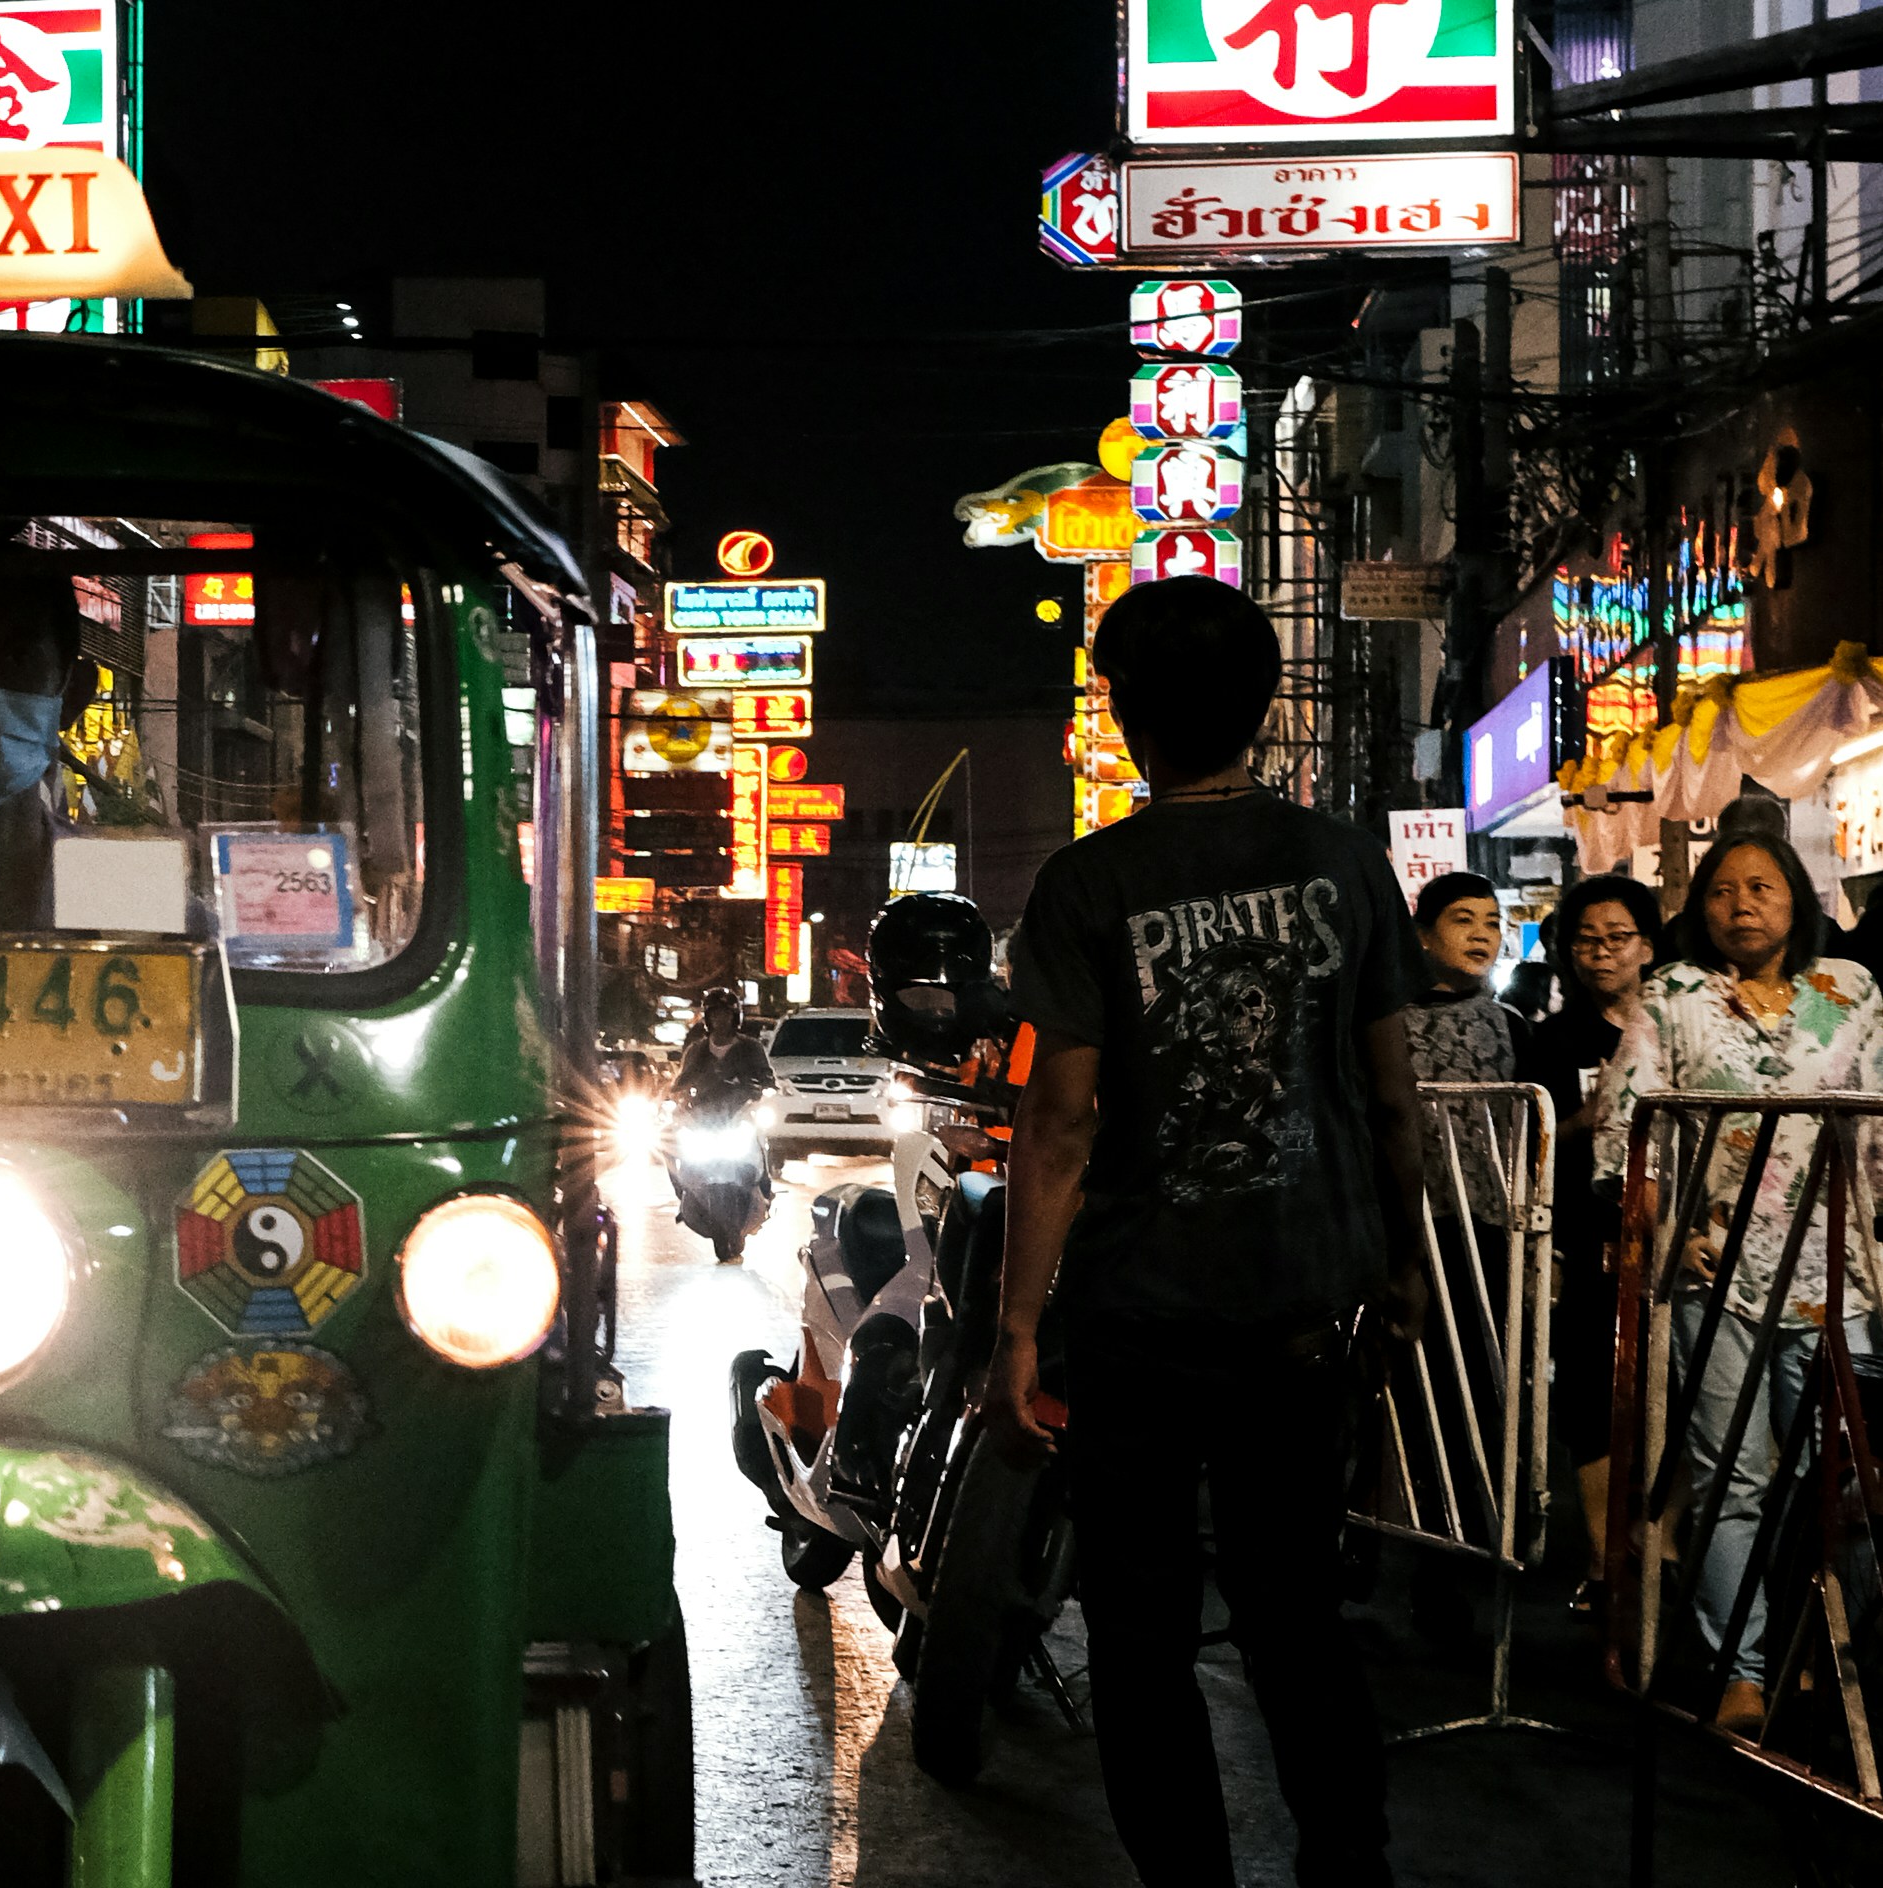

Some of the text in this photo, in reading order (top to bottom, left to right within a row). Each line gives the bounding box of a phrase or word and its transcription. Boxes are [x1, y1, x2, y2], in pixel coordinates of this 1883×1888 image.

[1151, 188, 1490, 238] ฮั่วเซ่งเฮง
[274, 870, 332, 895] 2563
[1126, 878, 1341, 1006] PIRATES
